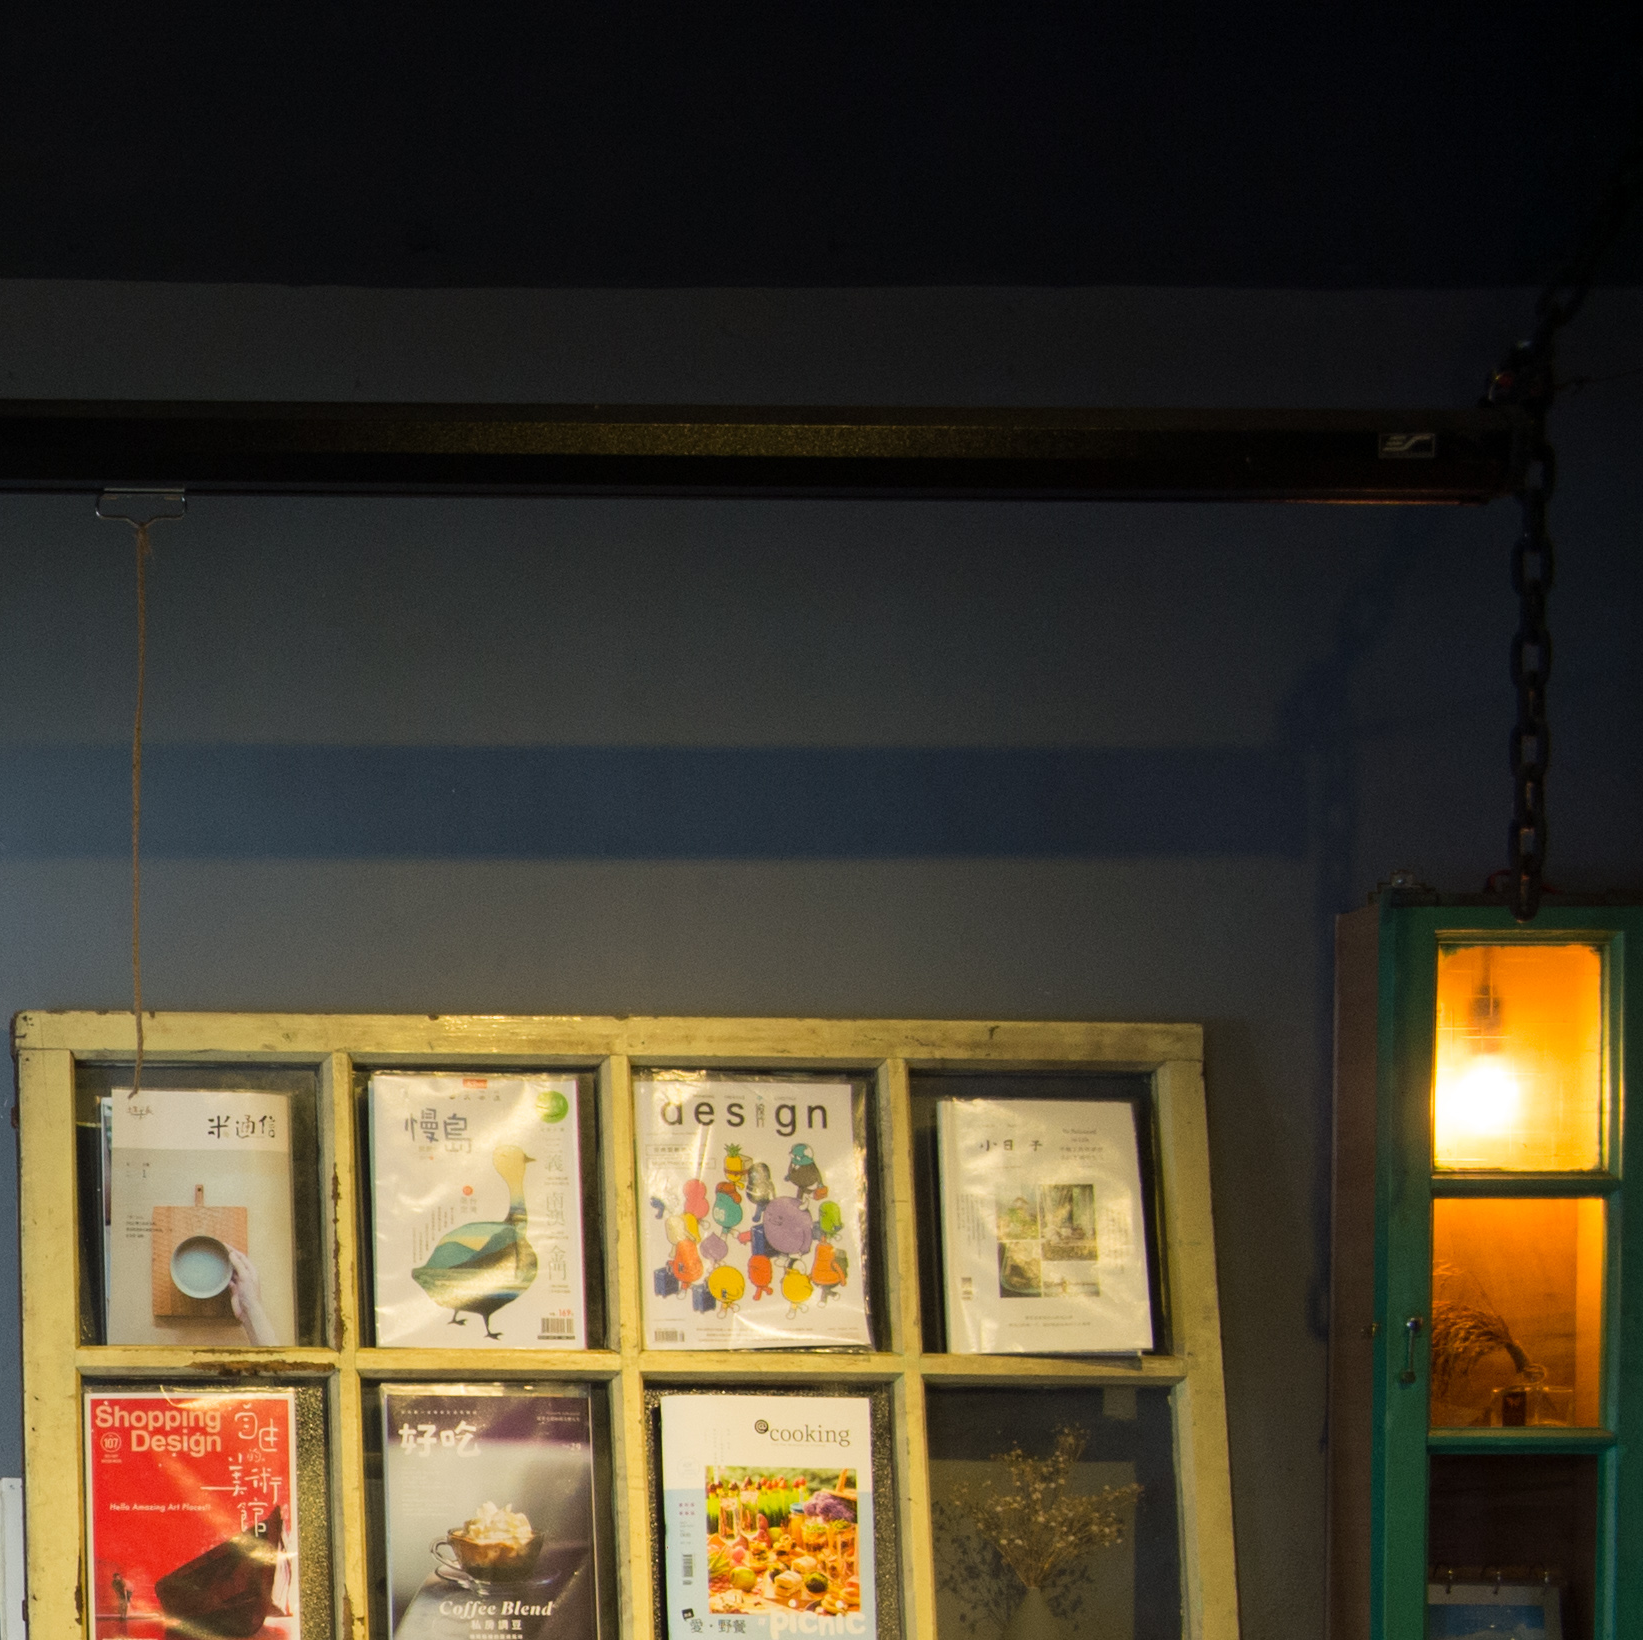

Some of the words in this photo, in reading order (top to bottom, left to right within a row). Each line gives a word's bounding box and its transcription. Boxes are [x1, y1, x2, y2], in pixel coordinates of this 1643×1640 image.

[207, 1115, 276, 1139] 米通信
[980, 1139, 1043, 1152] 小日子
[547, 1244, 566, 1281] 金門
[95, 1405, 221, 1431] Shopping
[130, 1429, 221, 1457] Design
[397, 1420, 482, 1458] 好吃
[109, 1503, 131, 1512] Hello
[132, 1503, 166, 1514] Amazing
[167, 1503, 181, 1511] Art
[439, 1600, 497, 1619] Coffee
[500, 1600, 554, 1616] Blend
[769, 1611, 866, 1640] picnic
